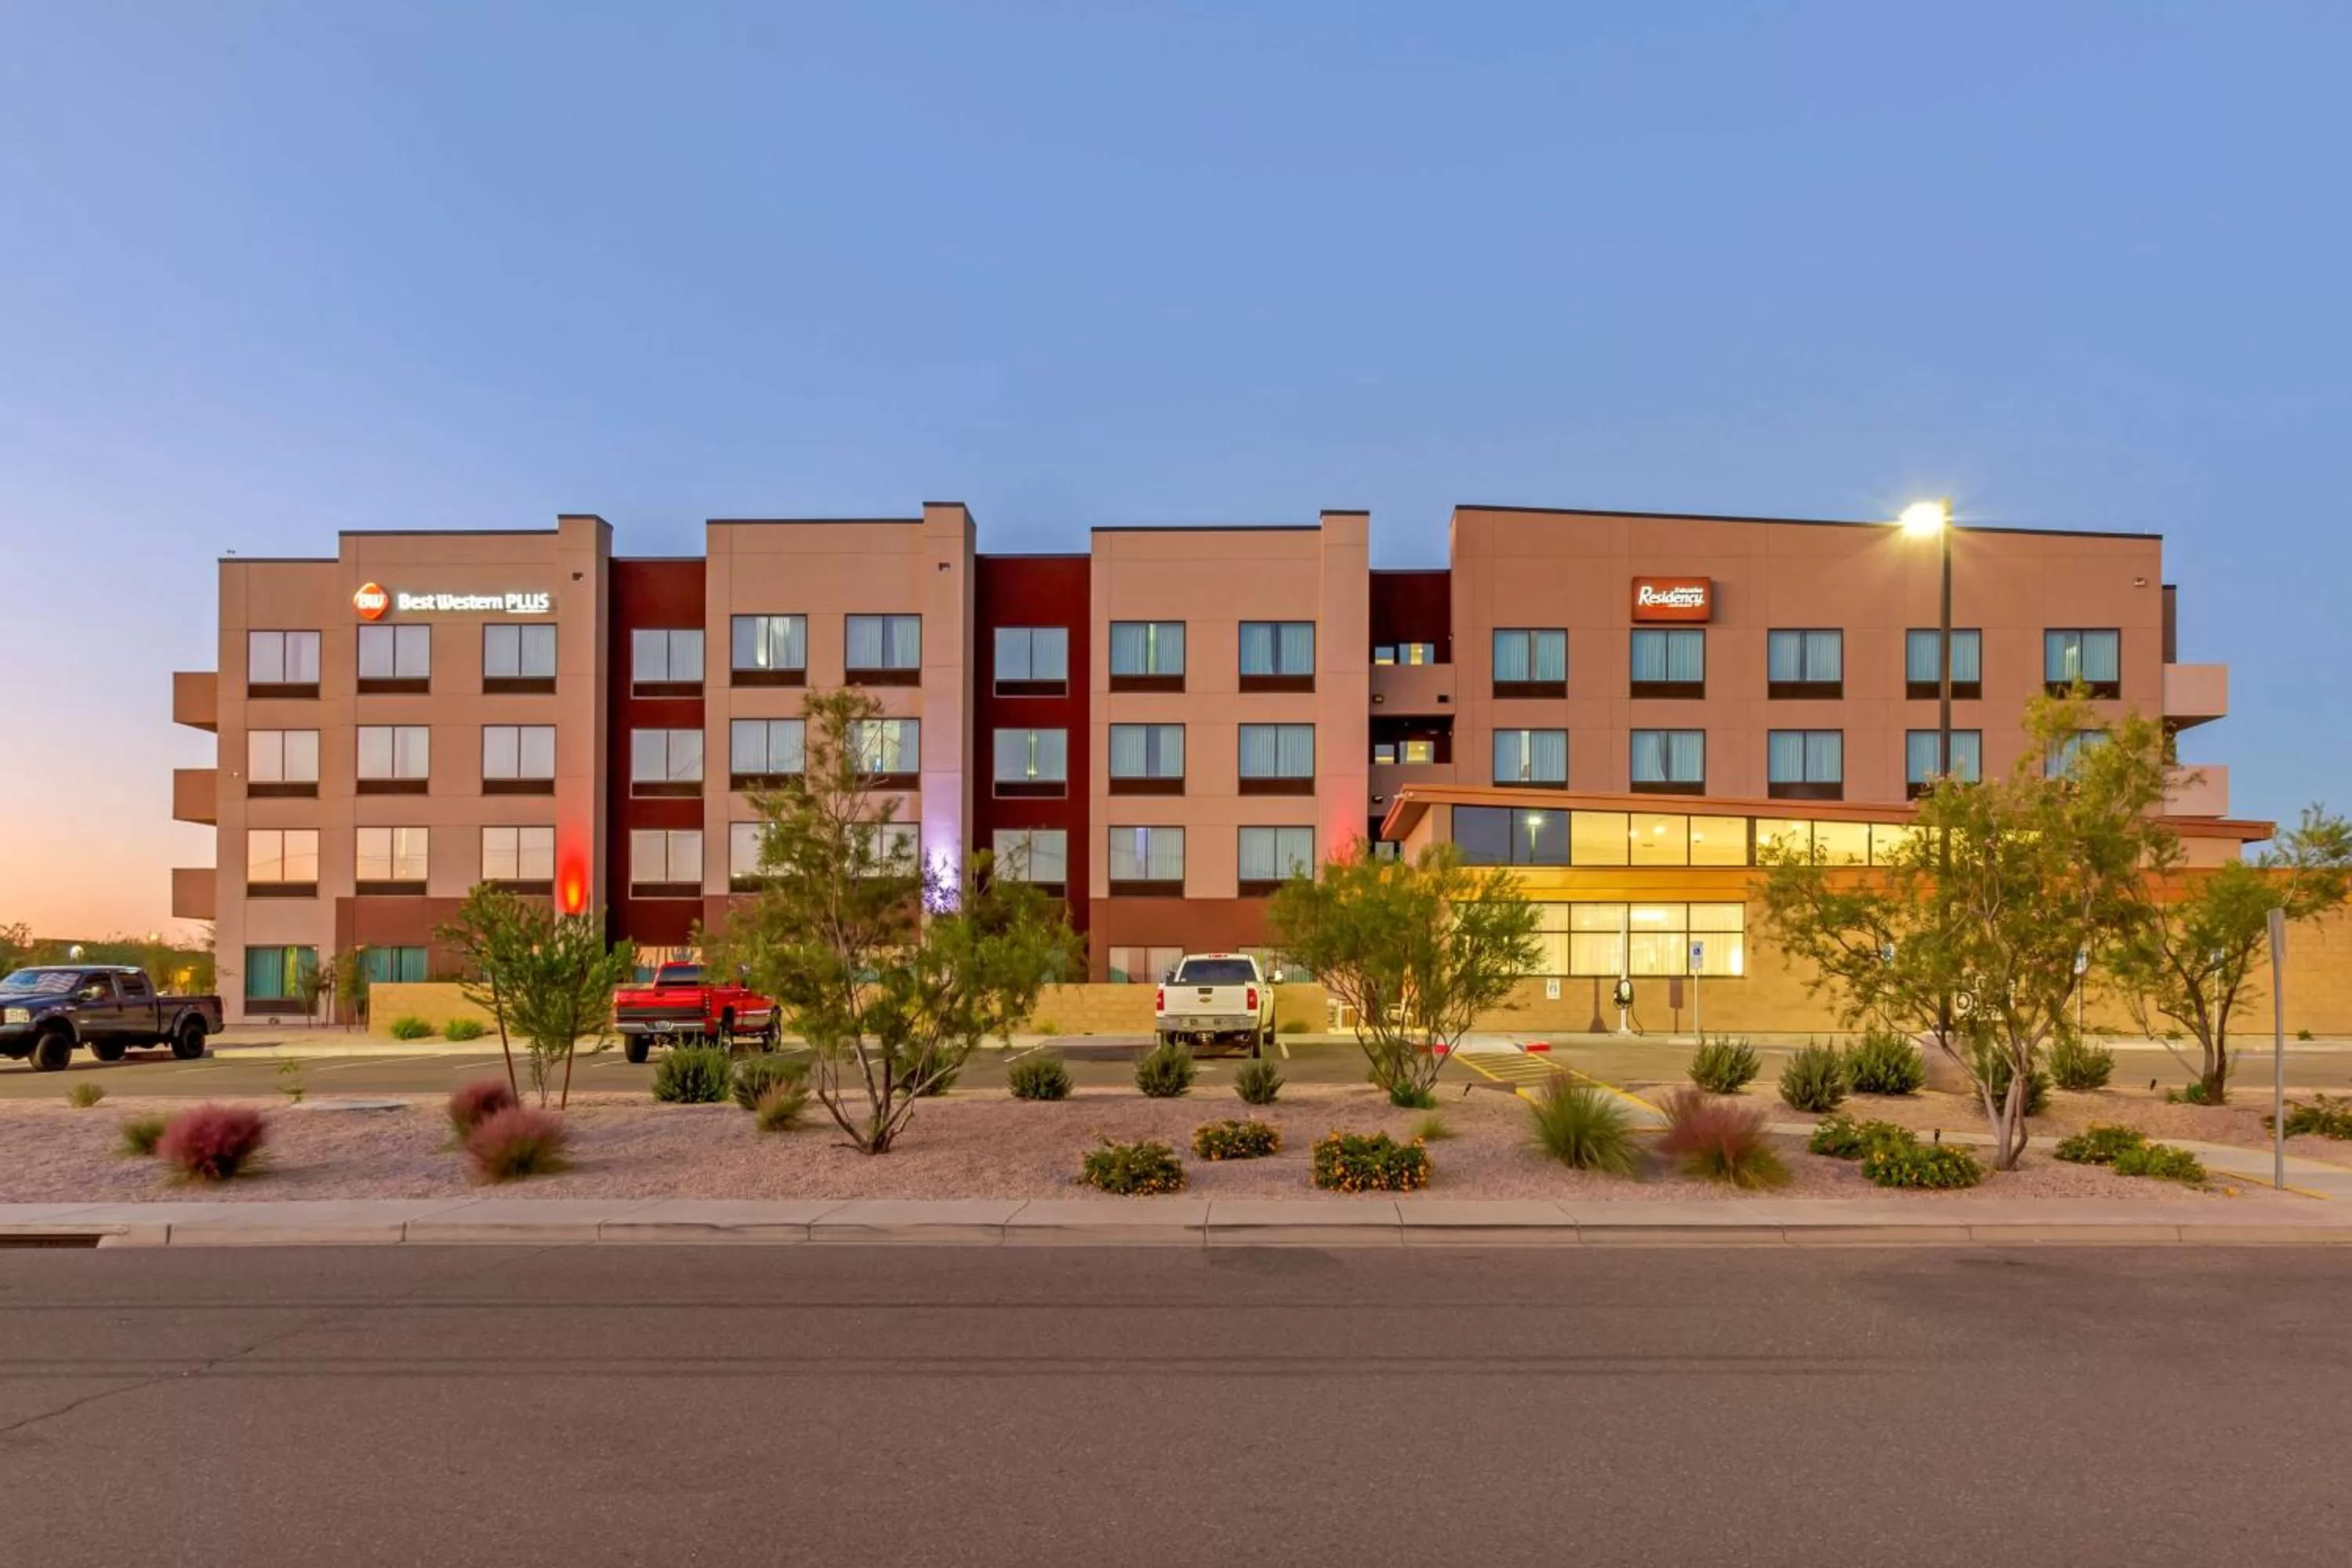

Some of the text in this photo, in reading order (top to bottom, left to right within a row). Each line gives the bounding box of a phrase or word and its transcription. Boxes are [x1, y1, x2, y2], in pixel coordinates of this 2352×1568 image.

[397, 593, 550, 610] Best Western PLUS
[1637, 586, 1705, 608] Residency
